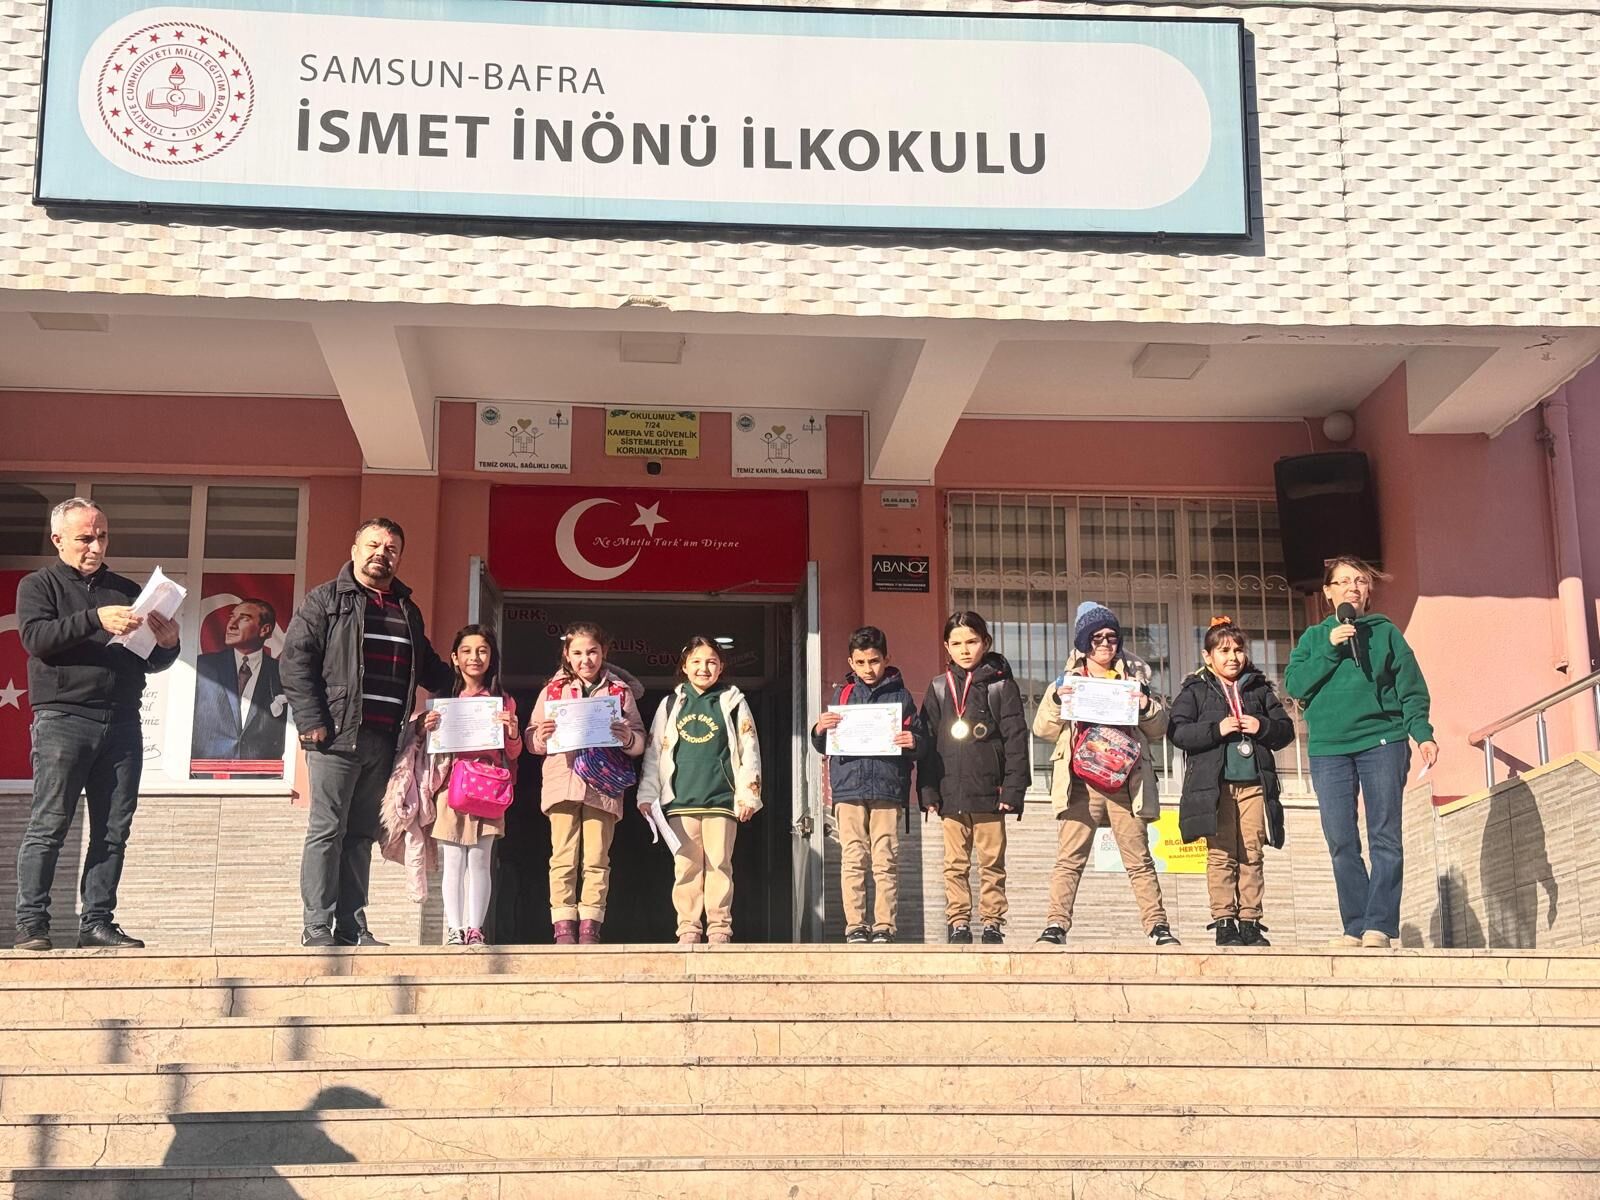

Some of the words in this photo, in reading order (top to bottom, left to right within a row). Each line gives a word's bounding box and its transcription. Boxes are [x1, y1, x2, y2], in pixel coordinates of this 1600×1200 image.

[174, 47, 205, 62] MİLLİ
[126, 47, 173, 101] CUMHURİYETİ
[204, 59, 227, 92] EĞİTİM
[299, 53, 605, 94] SAMSUN-BAFRA
[128, 104, 164, 136] TÜRKİYE
[186, 94, 225, 136] BAKANLIĞI
[297, 97, 490, 158] İSMET
[513, 107, 717, 167] İNÖNÜ
[743, 116, 1046, 175] İLKOKULU
[629, 412, 676, 420] OKULUMUZ
[607, 429, 642, 437] KAMERA
[656, 429, 698, 439] GÜVENLİK
[620, 437, 684, 447] SİSTEMLERİYLE
[616, 447, 688, 456] KORUNMAKTADIR
[520, 461, 549, 469] SAĞLIKLI
[780, 467, 806, 475] SAĞLIKLI
[592, 536, 611, 548] Ne
[612, 537, 651, 547] Mutlu
[701, 538, 740, 550] Diyene
[873, 560, 928, 574] ABANOZ
